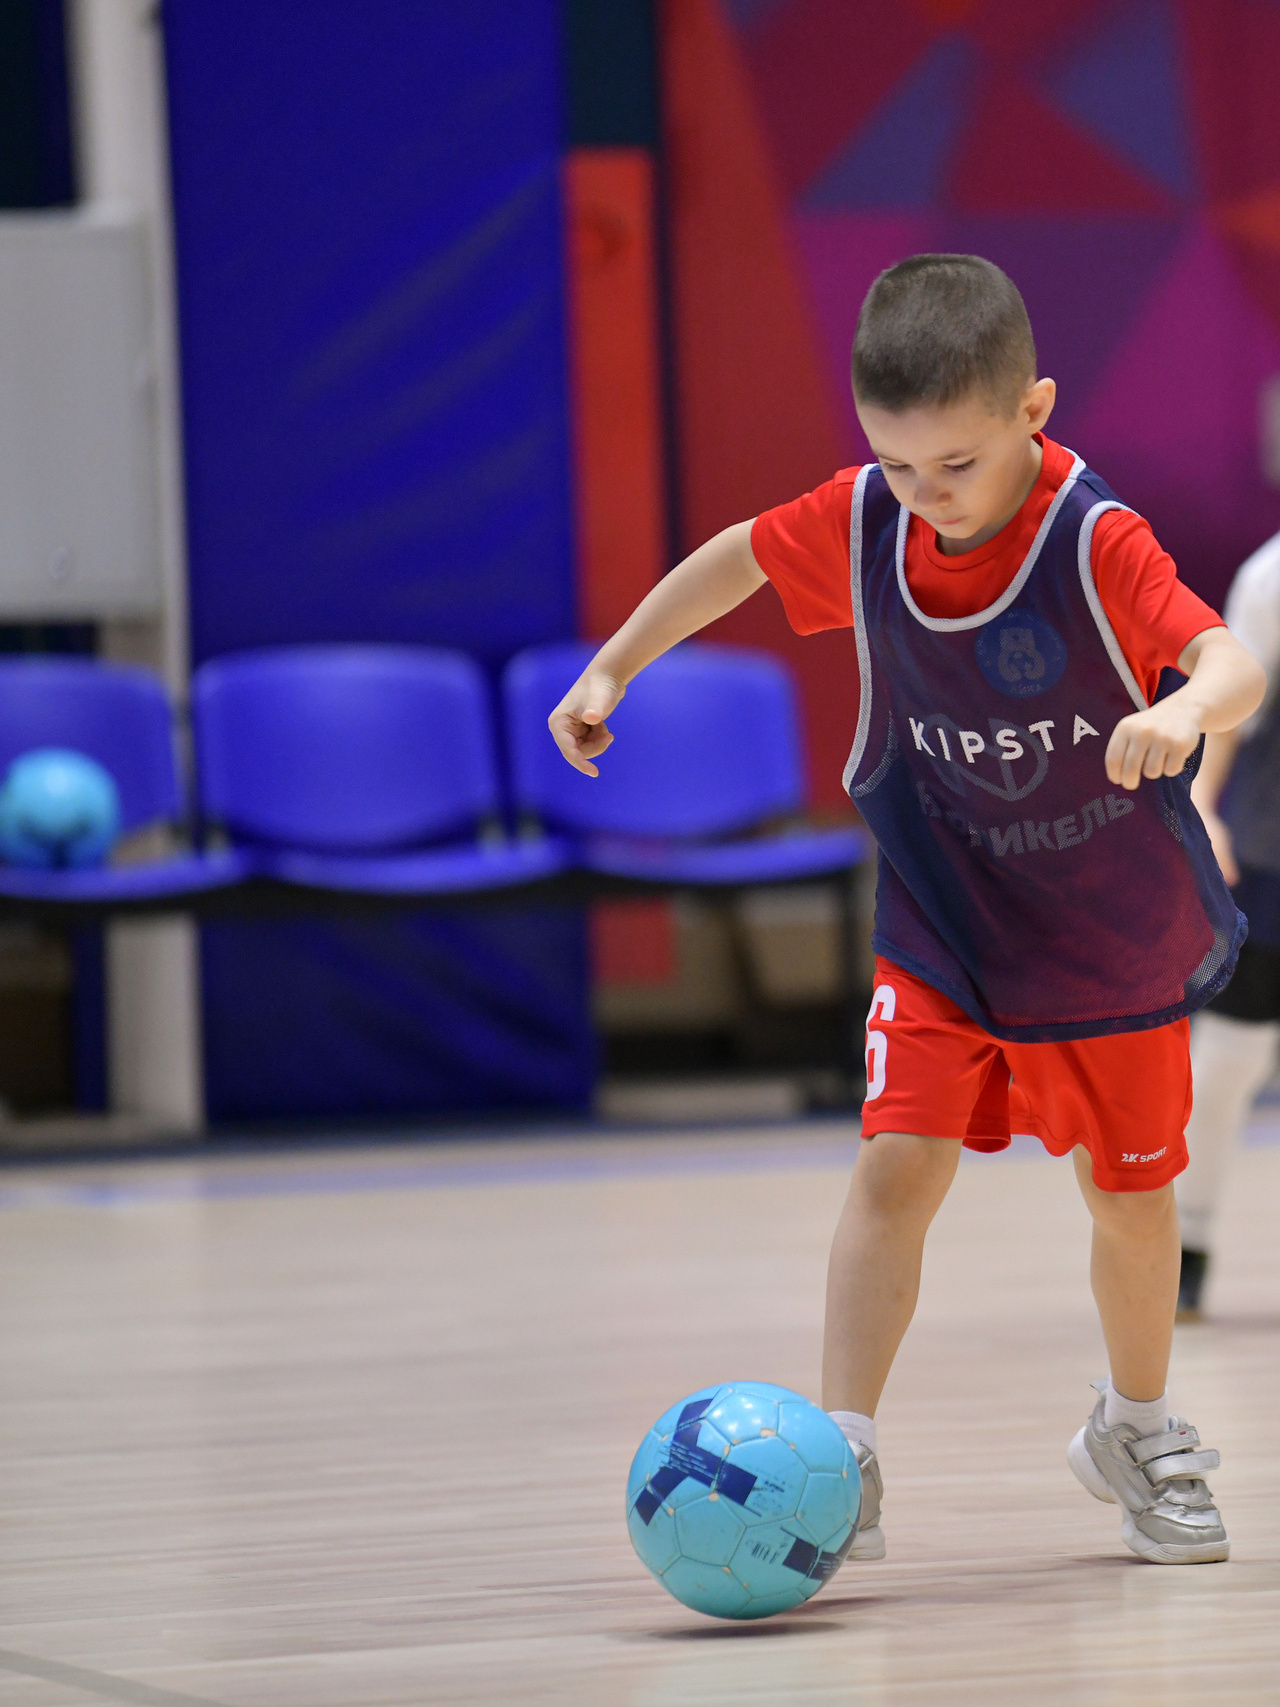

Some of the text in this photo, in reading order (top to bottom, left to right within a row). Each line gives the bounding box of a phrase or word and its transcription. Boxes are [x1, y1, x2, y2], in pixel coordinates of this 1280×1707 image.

[908, 714, 1100, 763] KIPSTA
[1121, 1146, 1167, 1162] 2K SPORT
